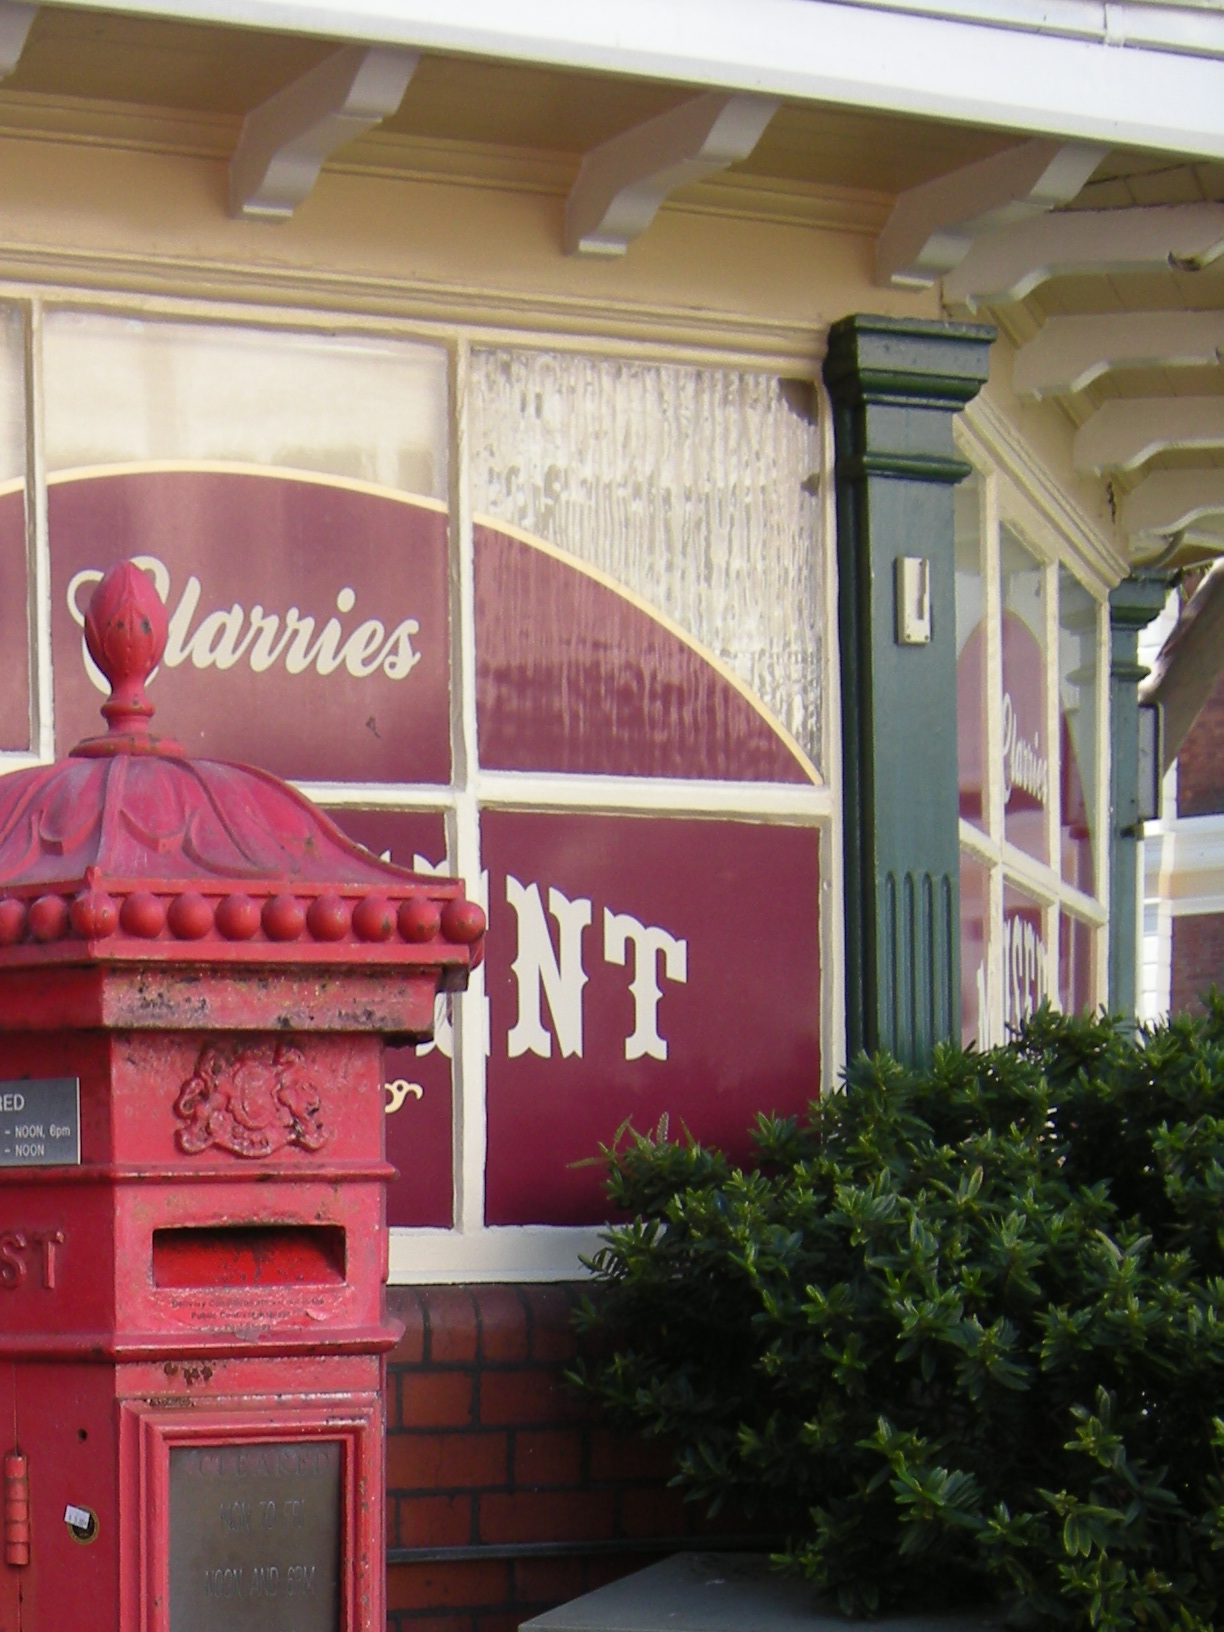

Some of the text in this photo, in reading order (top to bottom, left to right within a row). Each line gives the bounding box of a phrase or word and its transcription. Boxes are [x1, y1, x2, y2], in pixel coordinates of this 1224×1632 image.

[66, 555, 422, 696] Clarries
[15, 1124, 46, 1139] NOON,
[49, 1124, 71, 1138] 6pm
[15, 1143, 45, 1156] NOON
[199, 1450, 329, 1478] CLEARED
[260, 1501, 276, 1530] TO
[205, 1565, 316, 1599] NOON AND 6PM
